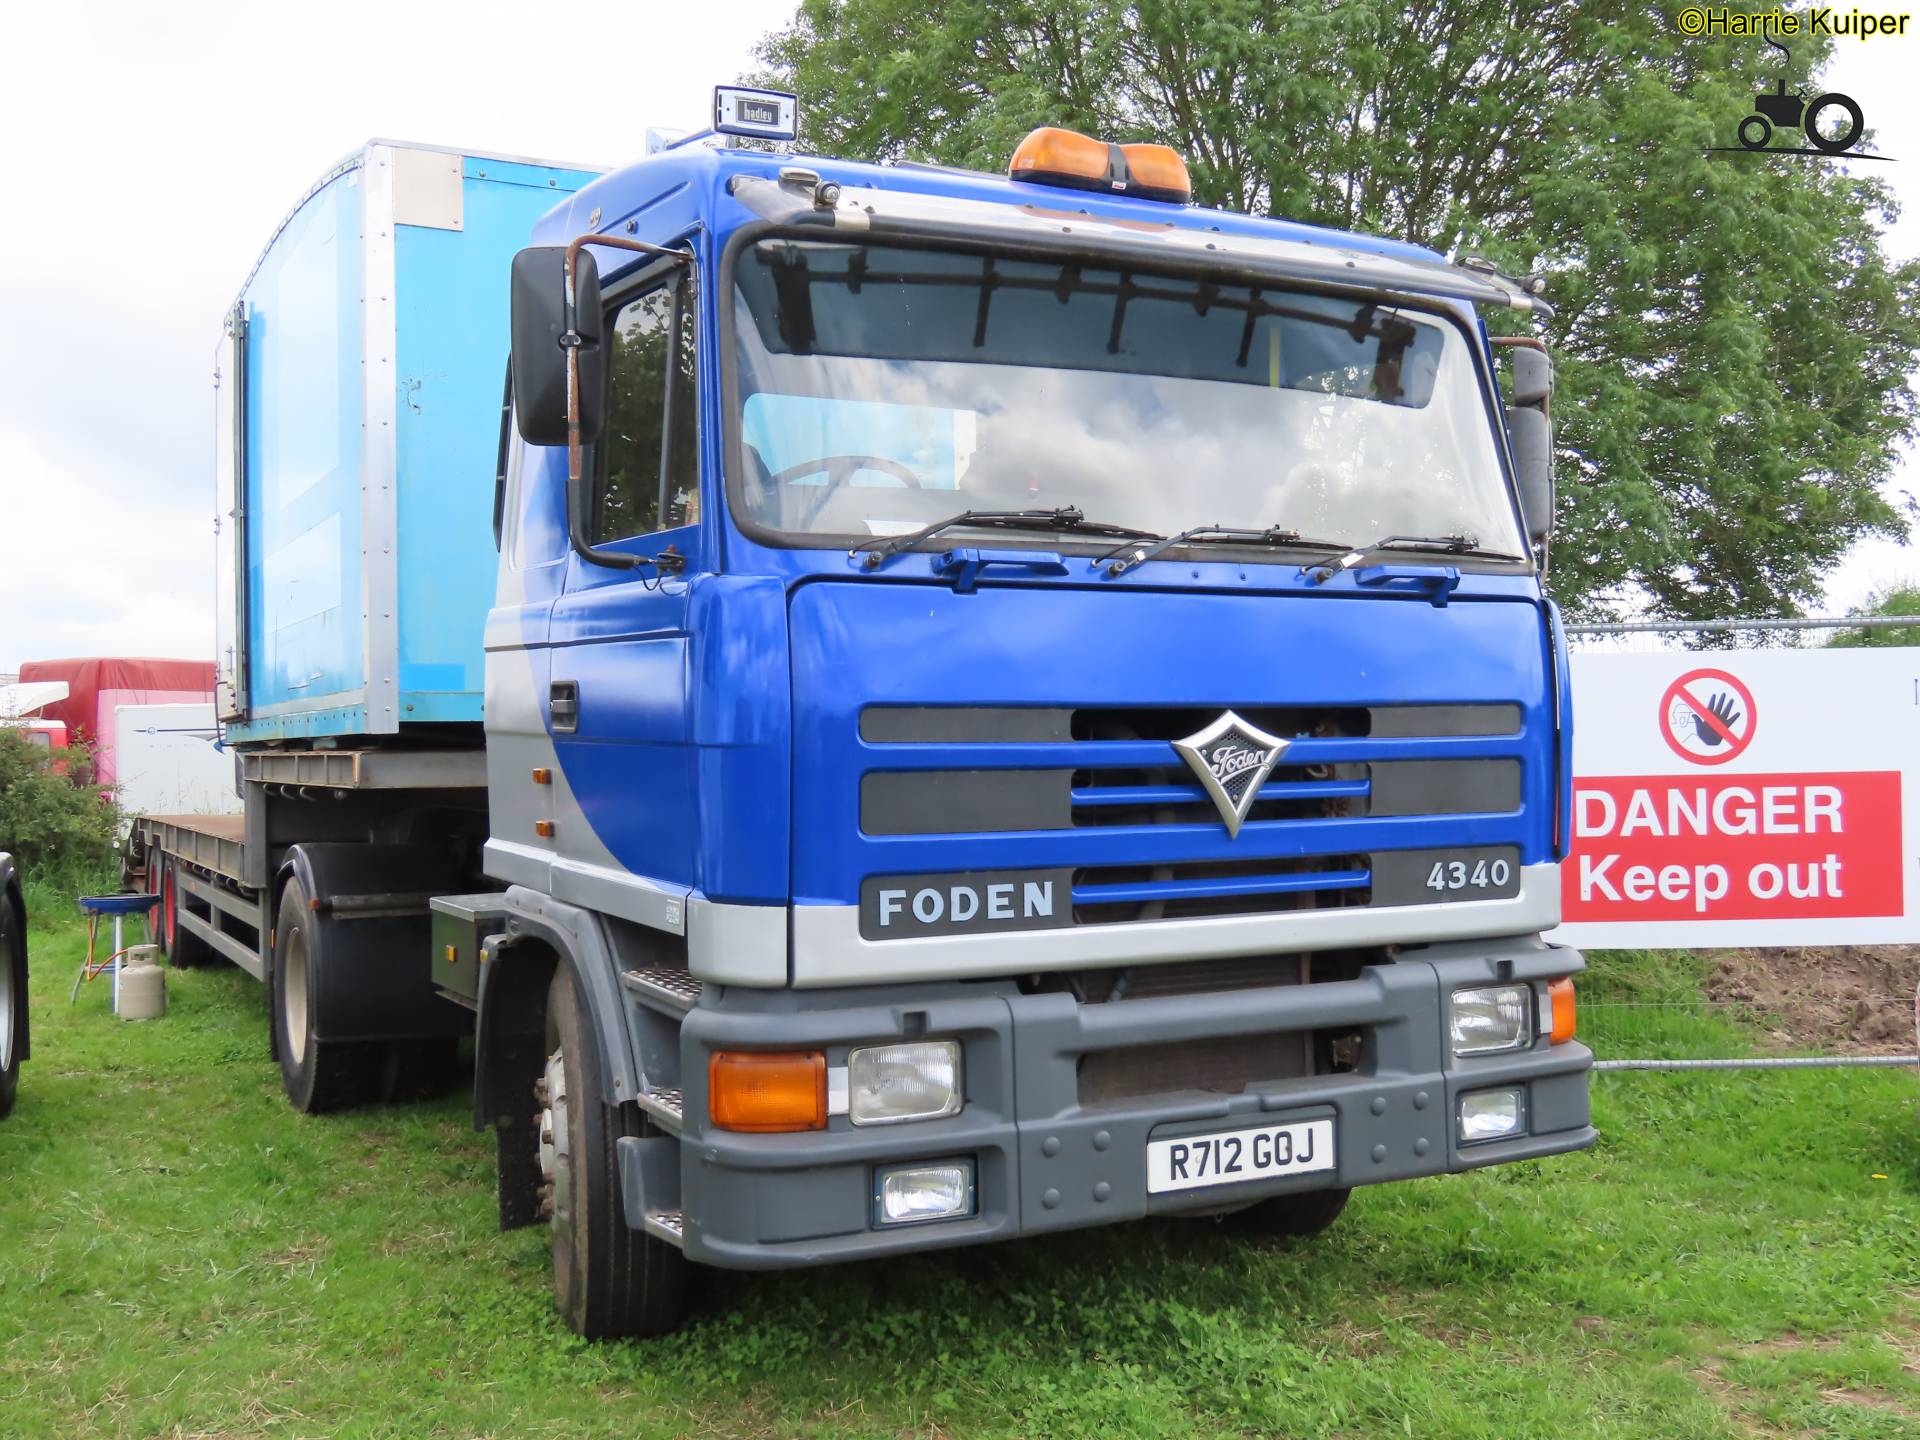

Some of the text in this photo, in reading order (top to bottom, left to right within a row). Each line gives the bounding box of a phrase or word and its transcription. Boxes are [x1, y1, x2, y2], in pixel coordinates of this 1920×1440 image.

[1210, 745, 1267, 781] Foden
[1574, 785, 1844, 838] DANGER
[1426, 859, 1510, 890] 4340
[1579, 854, 1843, 913] Keep out
[879, 881, 1053, 926] FODEN
[1170, 1128, 1314, 1181] R712 GOJ
